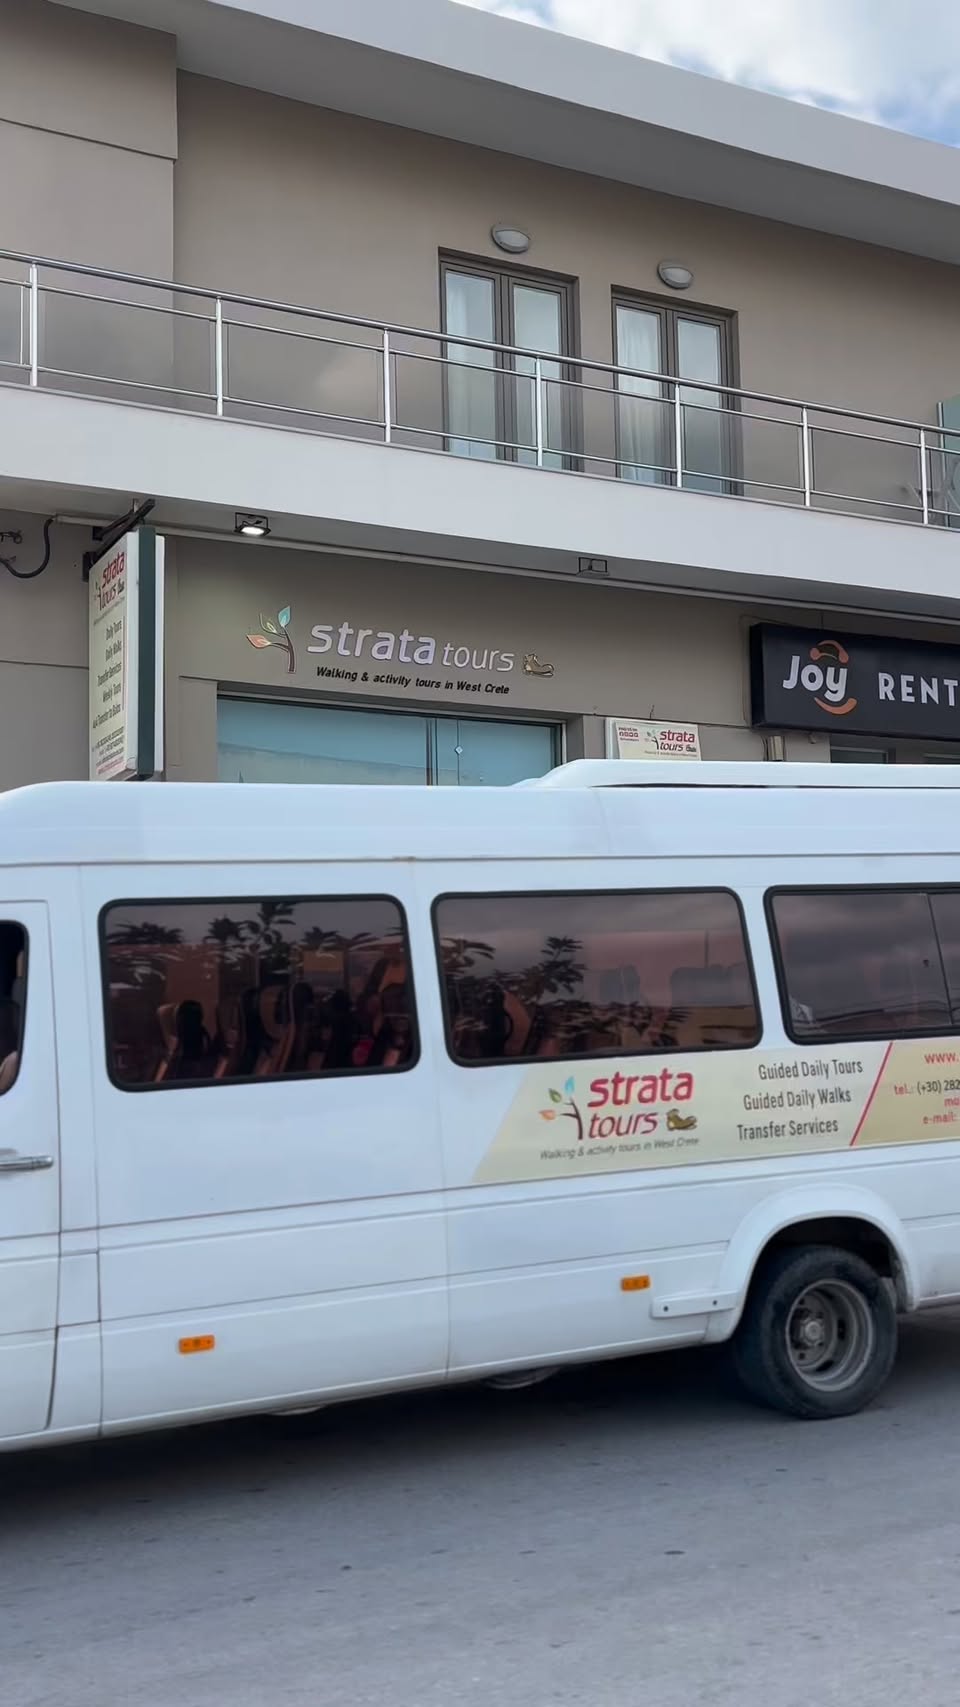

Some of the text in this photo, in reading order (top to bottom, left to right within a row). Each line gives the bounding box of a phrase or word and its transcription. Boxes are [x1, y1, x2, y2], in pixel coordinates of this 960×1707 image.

[102, 552, 125, 589] strata
[307, 621, 515, 672] strata tours
[316, 666, 510, 694] Walking & activity tours in West Crete
[782, 655, 959, 706] Joy RENT
[660, 730, 695, 743] strata
[660, 742, 684, 752] tours
[758, 1059, 863, 1080] Guided Daily Tours
[587, 1068, 694, 1108] strata
[743, 1087, 852, 1111] Guided Daily Walks
[917, 1079, 941, 1095] (+30)
[588, 1112, 659, 1139] tours
[737, 1118, 839, 1141] Transfer Services
[540, 1147, 576, 1160] Walking
[577, 1147, 584, 1157] &
[586, 1144, 617, 1156] activity
[618, 1142, 641, 1152] tours
[654, 1138, 675, 1149] West
